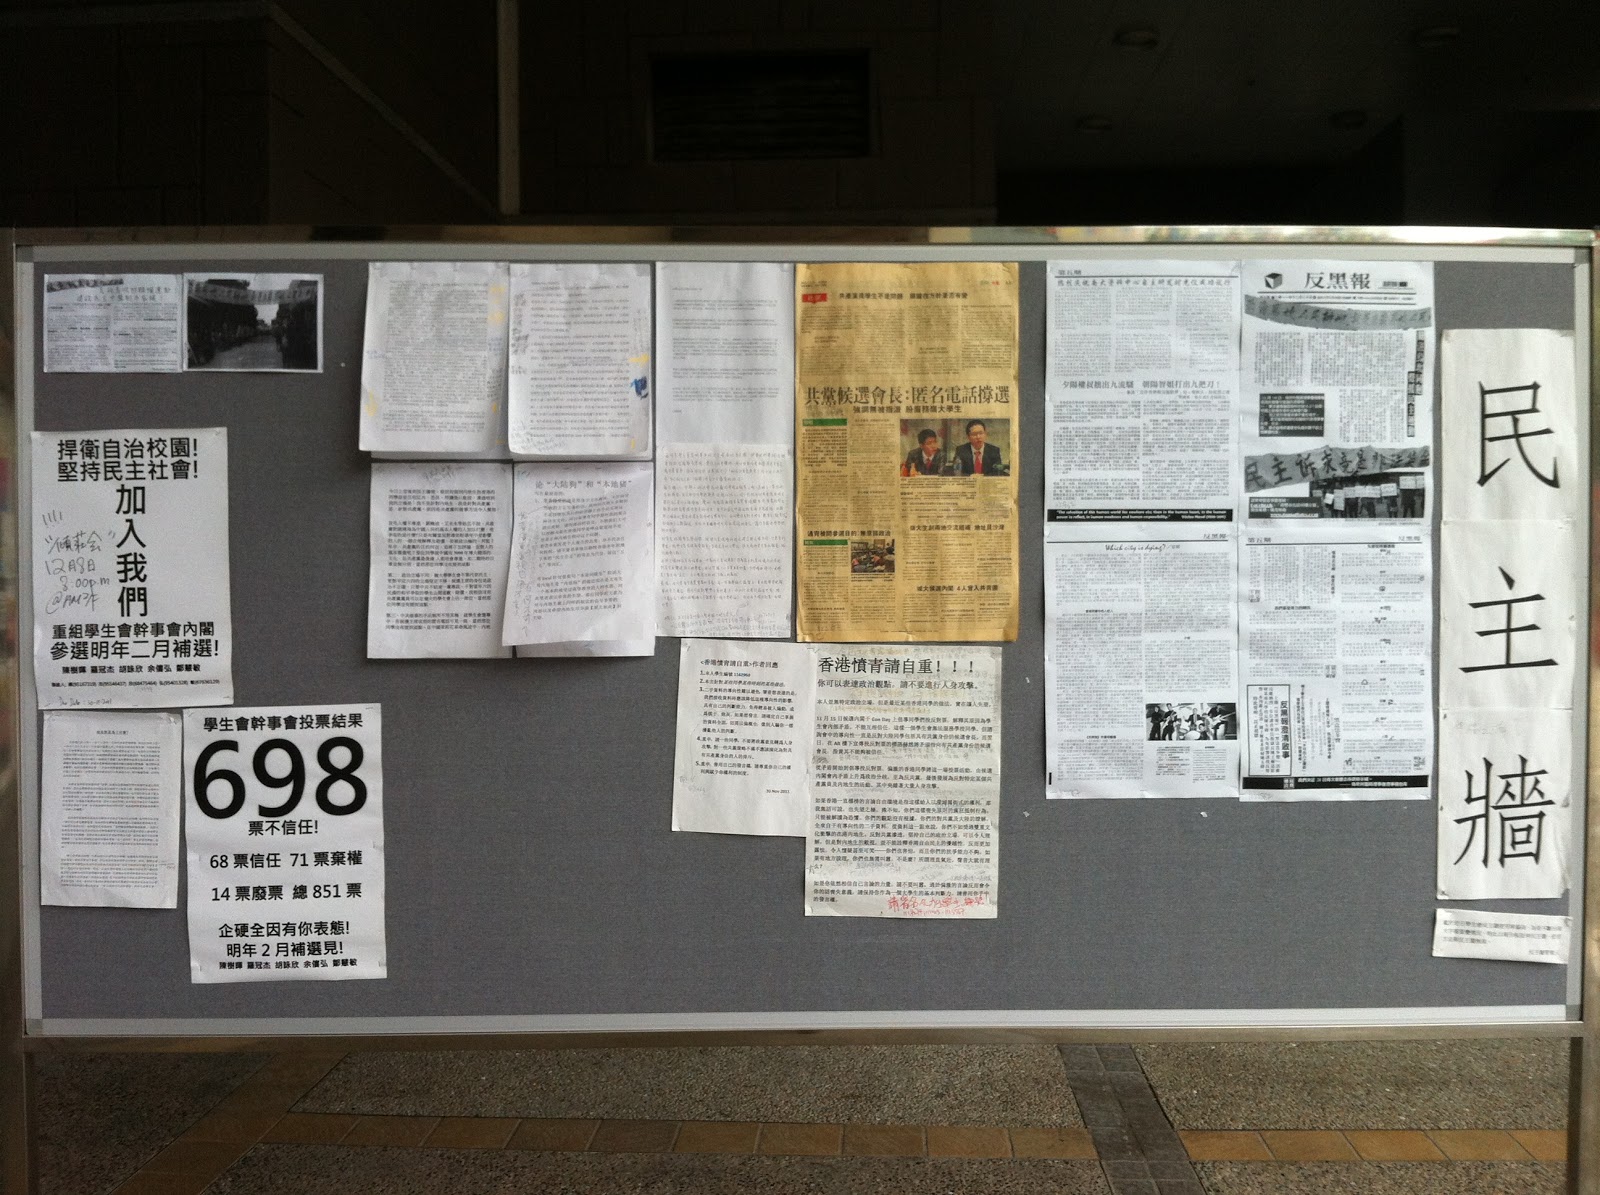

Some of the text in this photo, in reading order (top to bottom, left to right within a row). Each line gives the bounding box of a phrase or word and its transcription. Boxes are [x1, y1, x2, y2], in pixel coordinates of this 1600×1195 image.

[1304, 272, 1370, 290] 反黑報
[58, 437, 198, 460] 捍衛自治校園!
[58, 460, 198, 482] 堅持民主社會!
[116, 484, 148, 618] 加入我們
[52, 621, 214, 640] 重組學生會幹事會內閣
[50, 639, 218, 660] 參選明年二月補選!
[204, 713, 363, 732] 學生會幹事會投票結果
[194, 736, 367, 820] 698
[248, 820, 318, 836] 票不信任!
[210, 850, 362, 869] 68 票信任 71 票棄權
[212, 883, 362, 901] 14 票廢票 總 851 票
[218, 920, 350, 939] 企硬全因有你表態!
[227, 941, 343, 958] 明年 2 月補選見!
